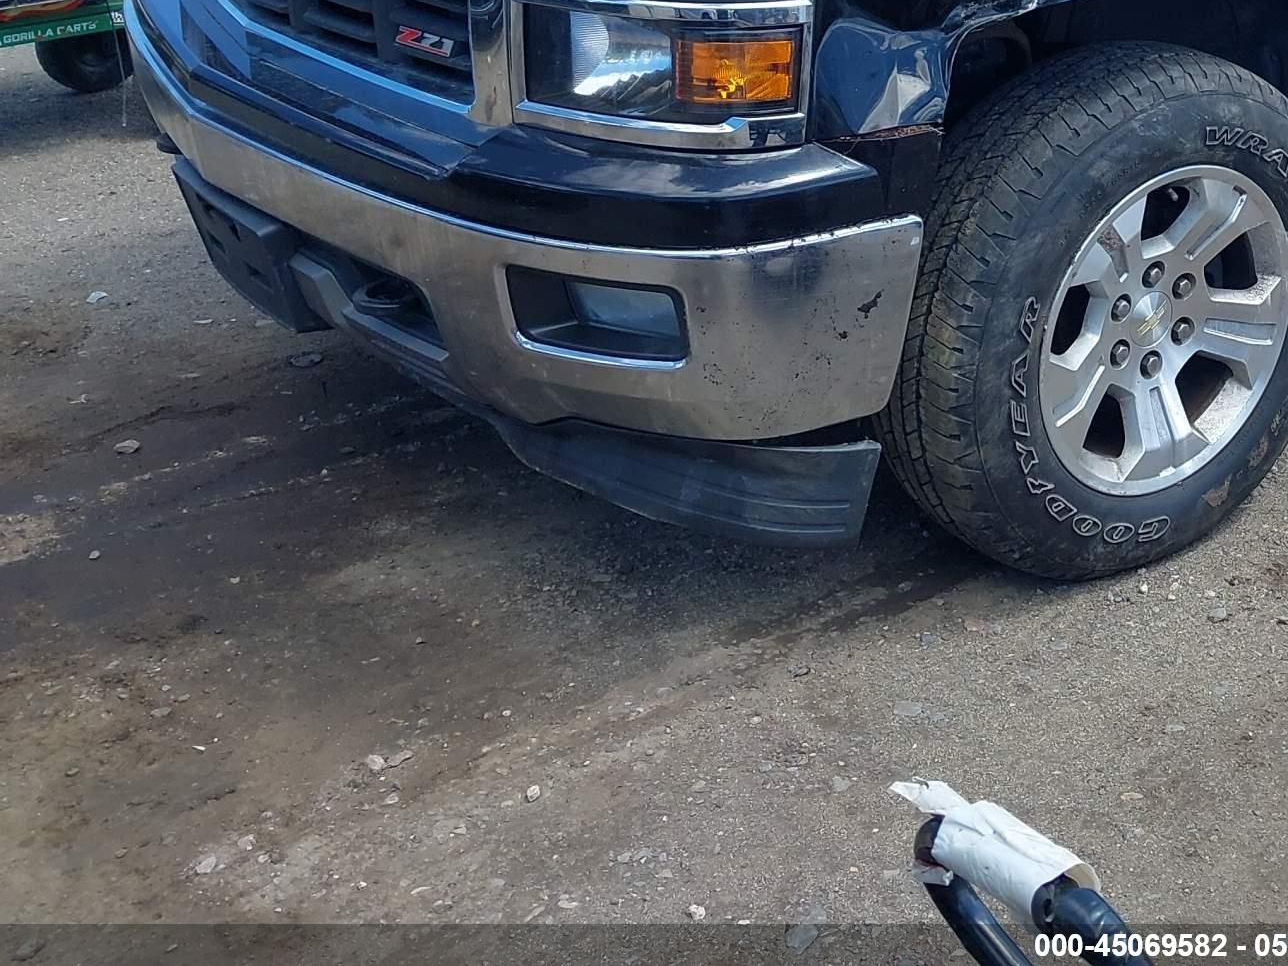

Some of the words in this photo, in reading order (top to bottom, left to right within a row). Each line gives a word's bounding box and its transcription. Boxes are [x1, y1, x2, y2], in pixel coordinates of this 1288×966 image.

[3, 28, 55, 44] GORILLA
[56, 20, 97, 35] CARTS
[395, 25, 455, 58] Z71
[1009, 295, 1172, 544] GOODYEAR
